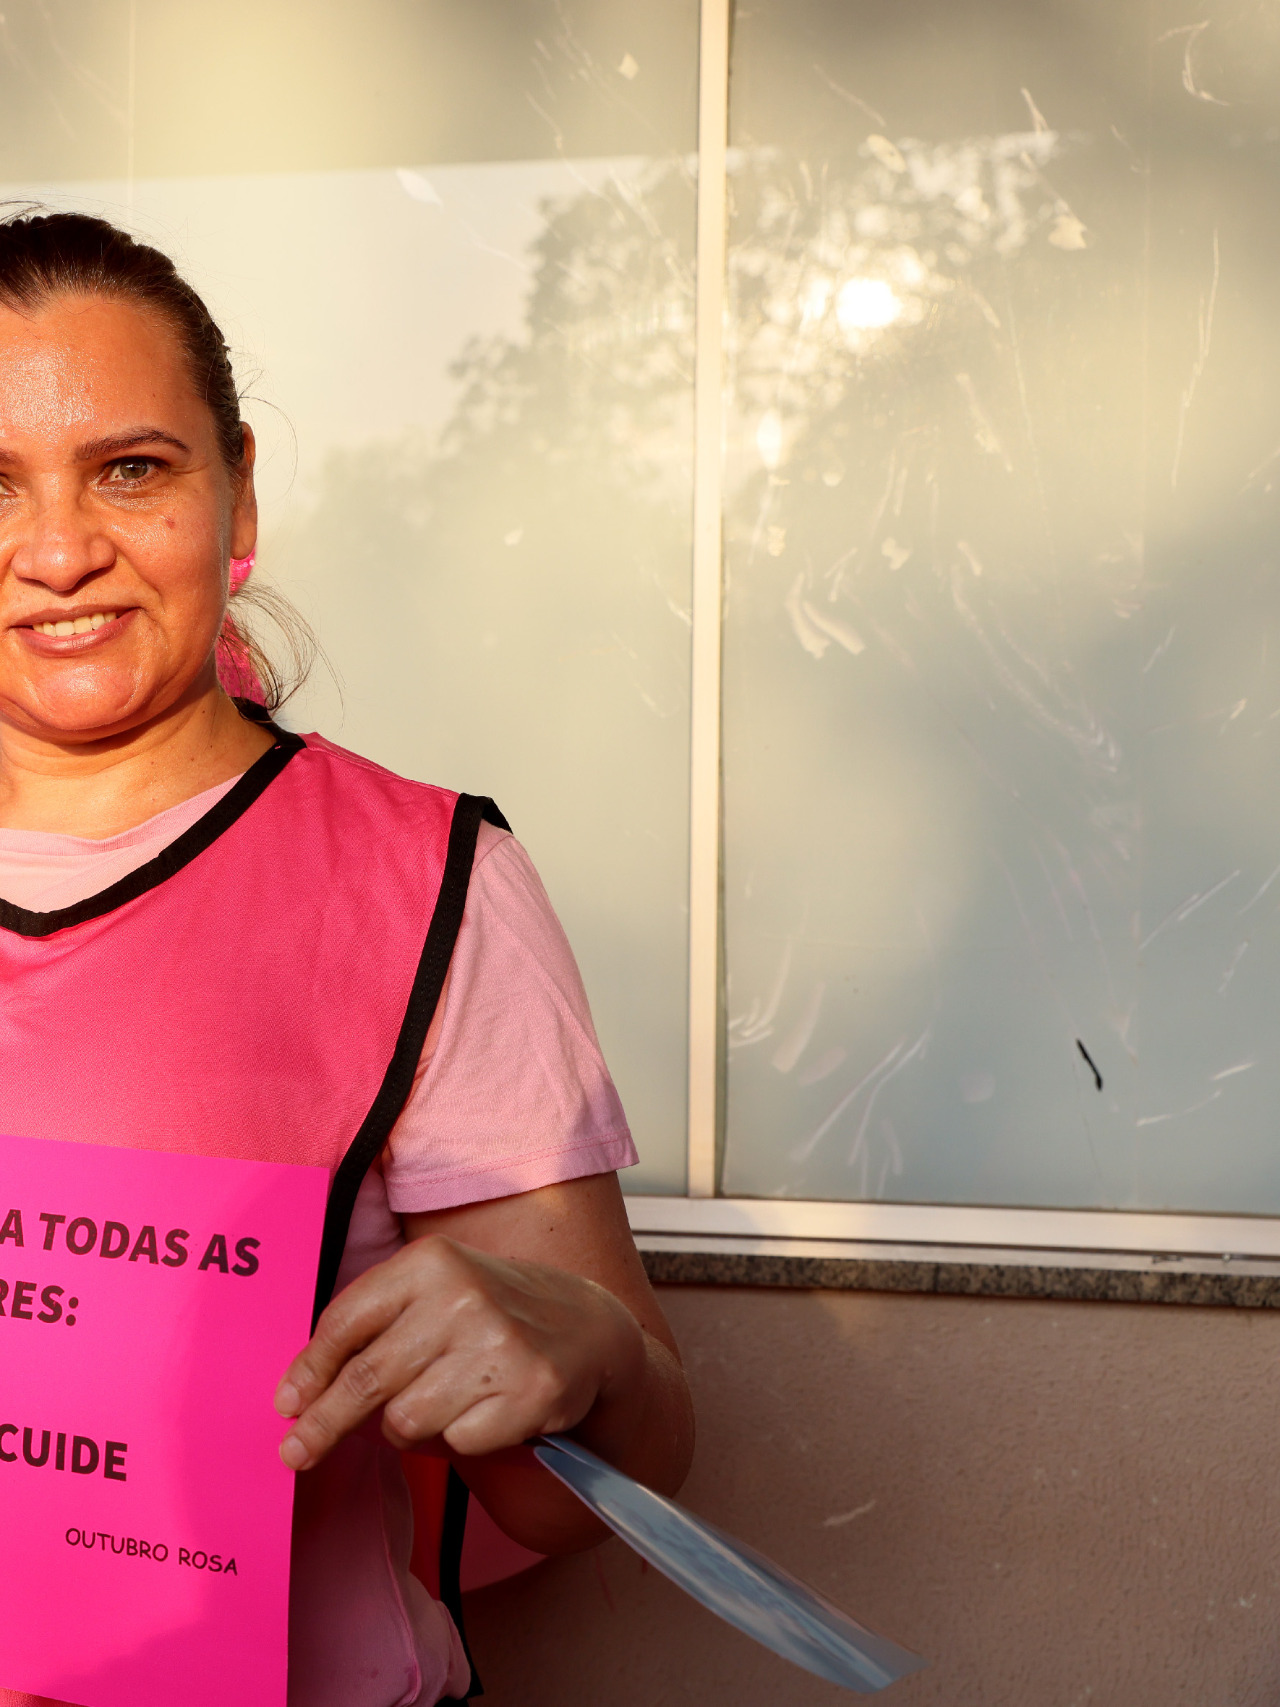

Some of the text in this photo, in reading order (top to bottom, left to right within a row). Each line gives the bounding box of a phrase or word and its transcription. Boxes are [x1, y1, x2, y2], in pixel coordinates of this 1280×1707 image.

[39, 1212, 190, 1267] TODAS
[198, 1233, 261, 1277] AS
[65, 1527, 238, 1576] OUTUBRO ROSA
